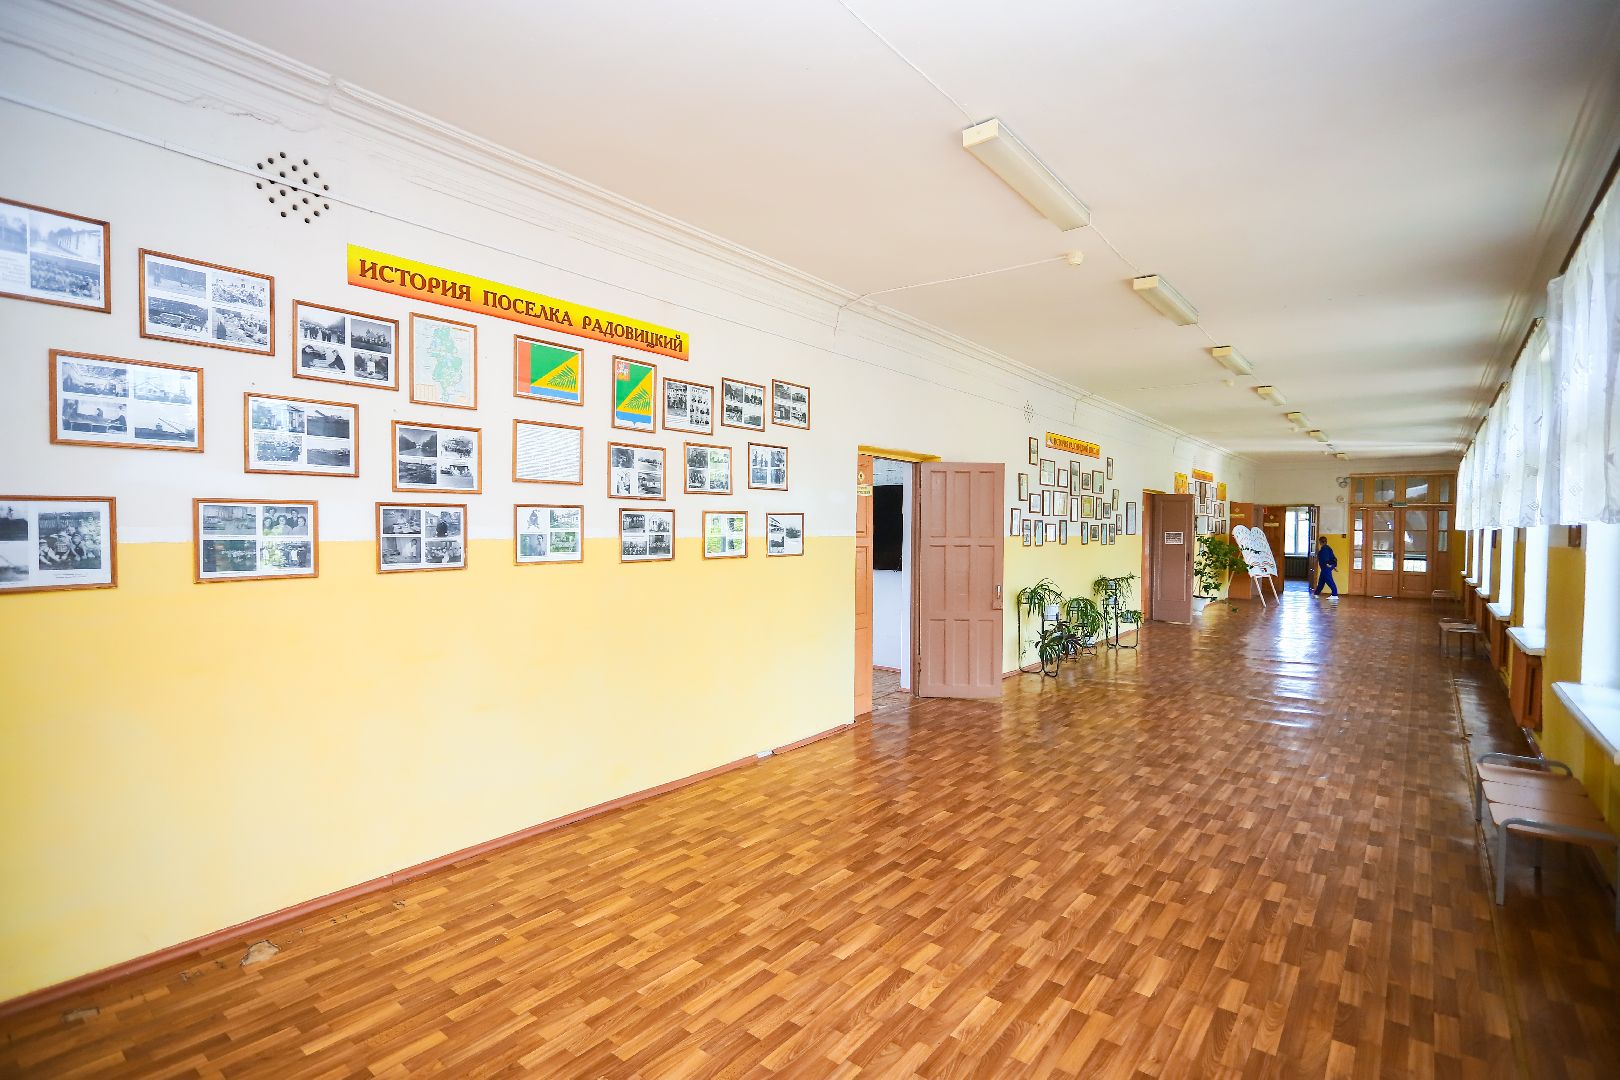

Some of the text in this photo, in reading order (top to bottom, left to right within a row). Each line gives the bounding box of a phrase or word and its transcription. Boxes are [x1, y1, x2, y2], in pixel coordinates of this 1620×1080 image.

[359, 259, 684, 353] ИСТОРИЯ ПОСЕЛКА РАДОВИЦКИЙ
